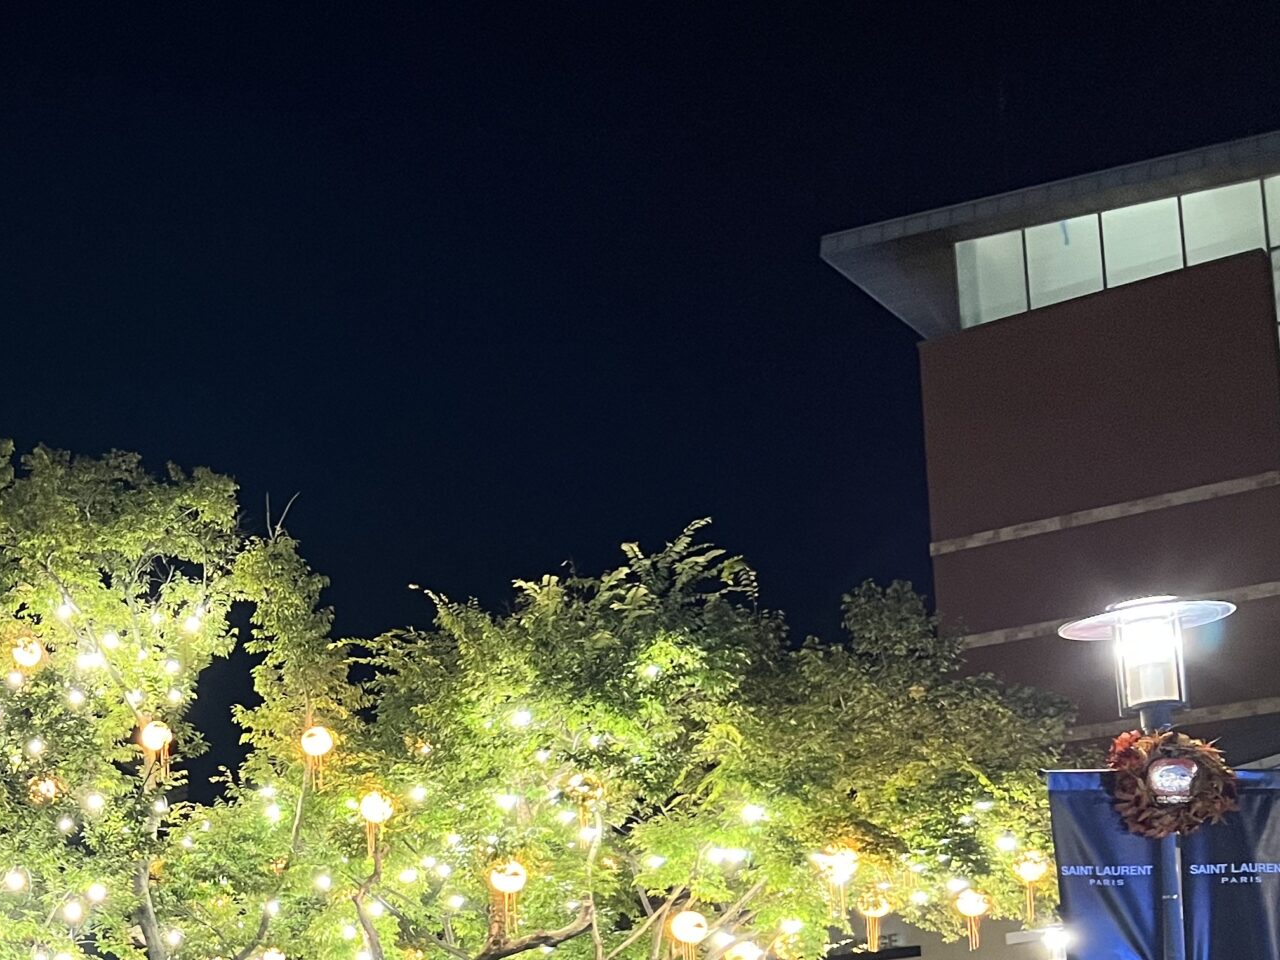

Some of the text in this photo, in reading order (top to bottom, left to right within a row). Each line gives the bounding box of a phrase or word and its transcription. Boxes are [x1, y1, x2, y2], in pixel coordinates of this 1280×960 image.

[1061, 865, 1153, 876] SAINT LAURENT
[1189, 862, 1280, 875] SAINT LAUREN
[1088, 879, 1125, 887] PARIS
[1221, 876, 1262, 884] PARIS
